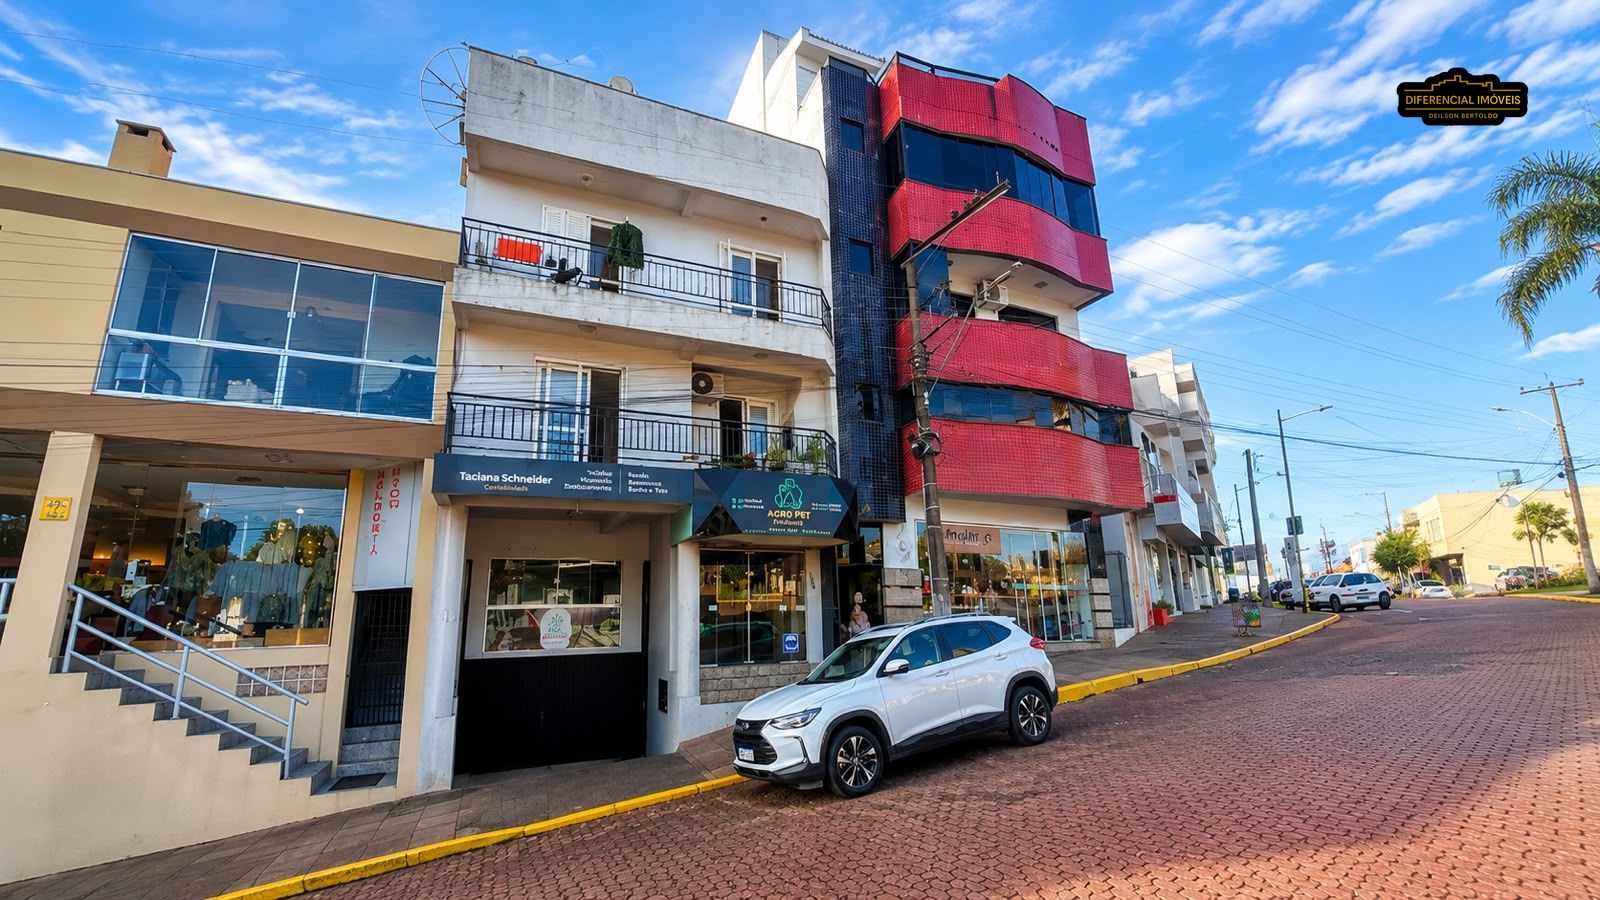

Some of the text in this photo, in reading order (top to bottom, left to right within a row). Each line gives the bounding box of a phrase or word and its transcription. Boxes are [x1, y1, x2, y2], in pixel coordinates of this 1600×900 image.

[459, 471, 553, 484] Taciana Schneider
[767, 509, 812, 520] AGRO PET
